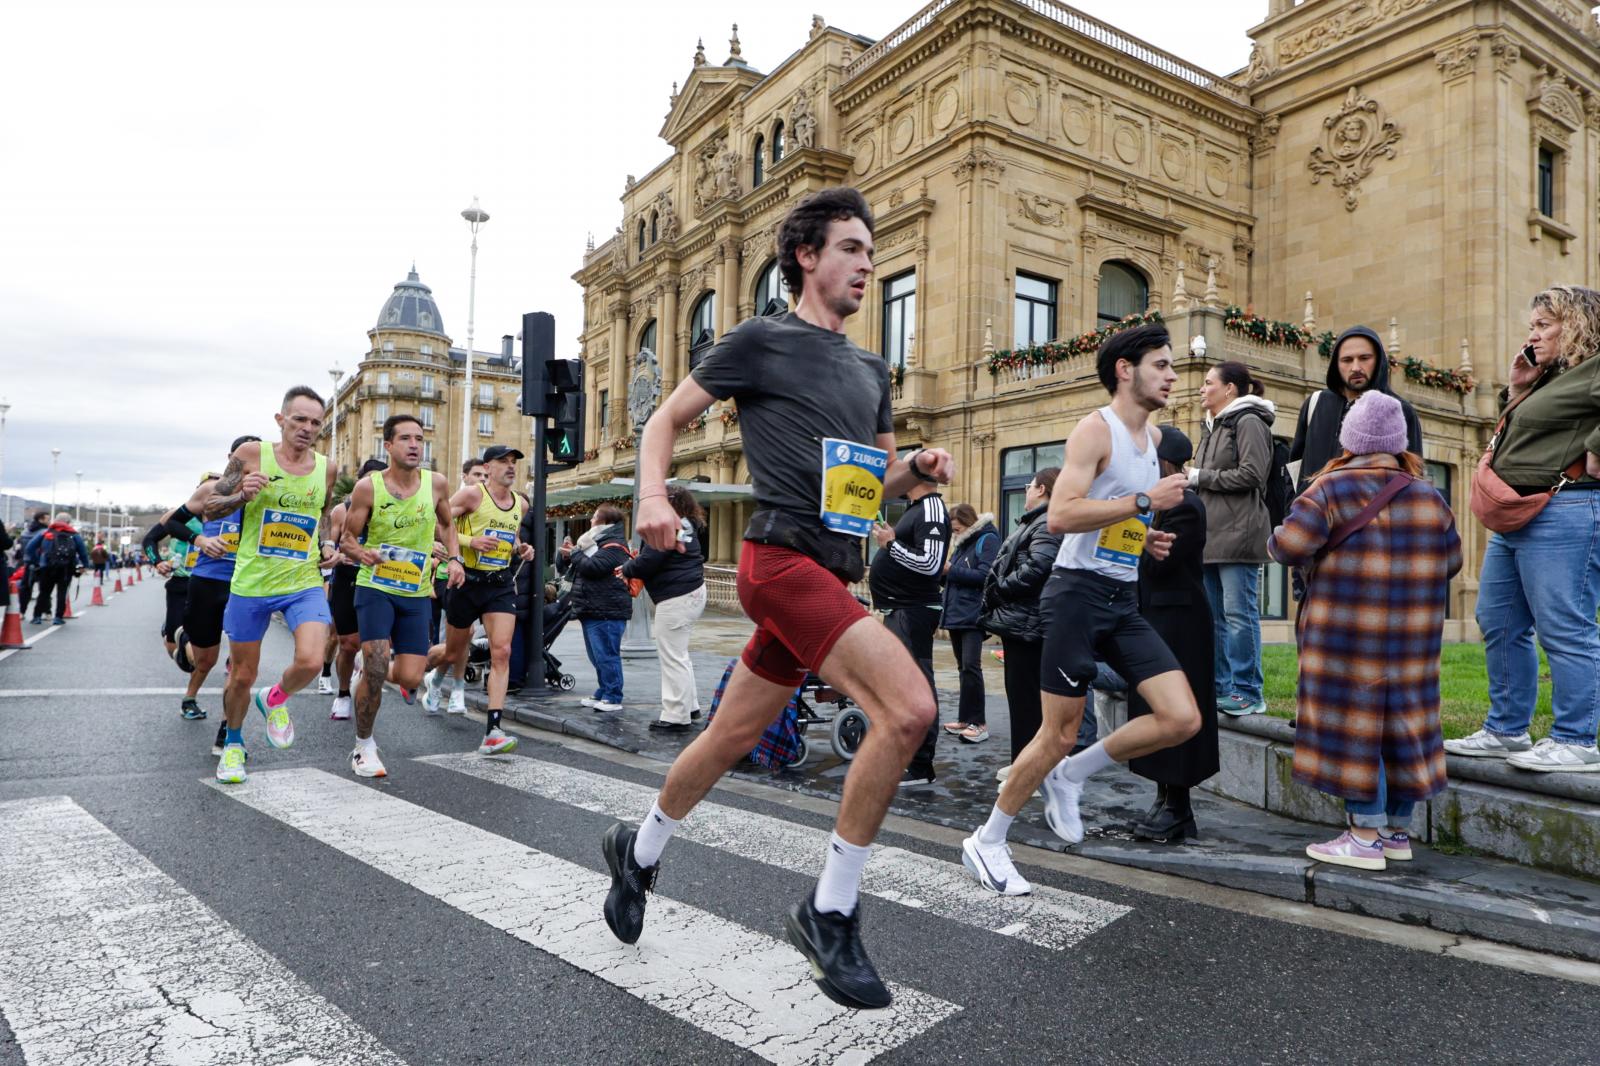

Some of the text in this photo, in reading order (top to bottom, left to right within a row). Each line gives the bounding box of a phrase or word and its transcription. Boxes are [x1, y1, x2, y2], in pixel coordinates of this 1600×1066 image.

[853, 452, 887, 468] ZURICH
[283, 515, 309, 525] ZURICH
[270, 530, 306, 542] MANUEL
[381, 564, 401, 573] MIGUEL
